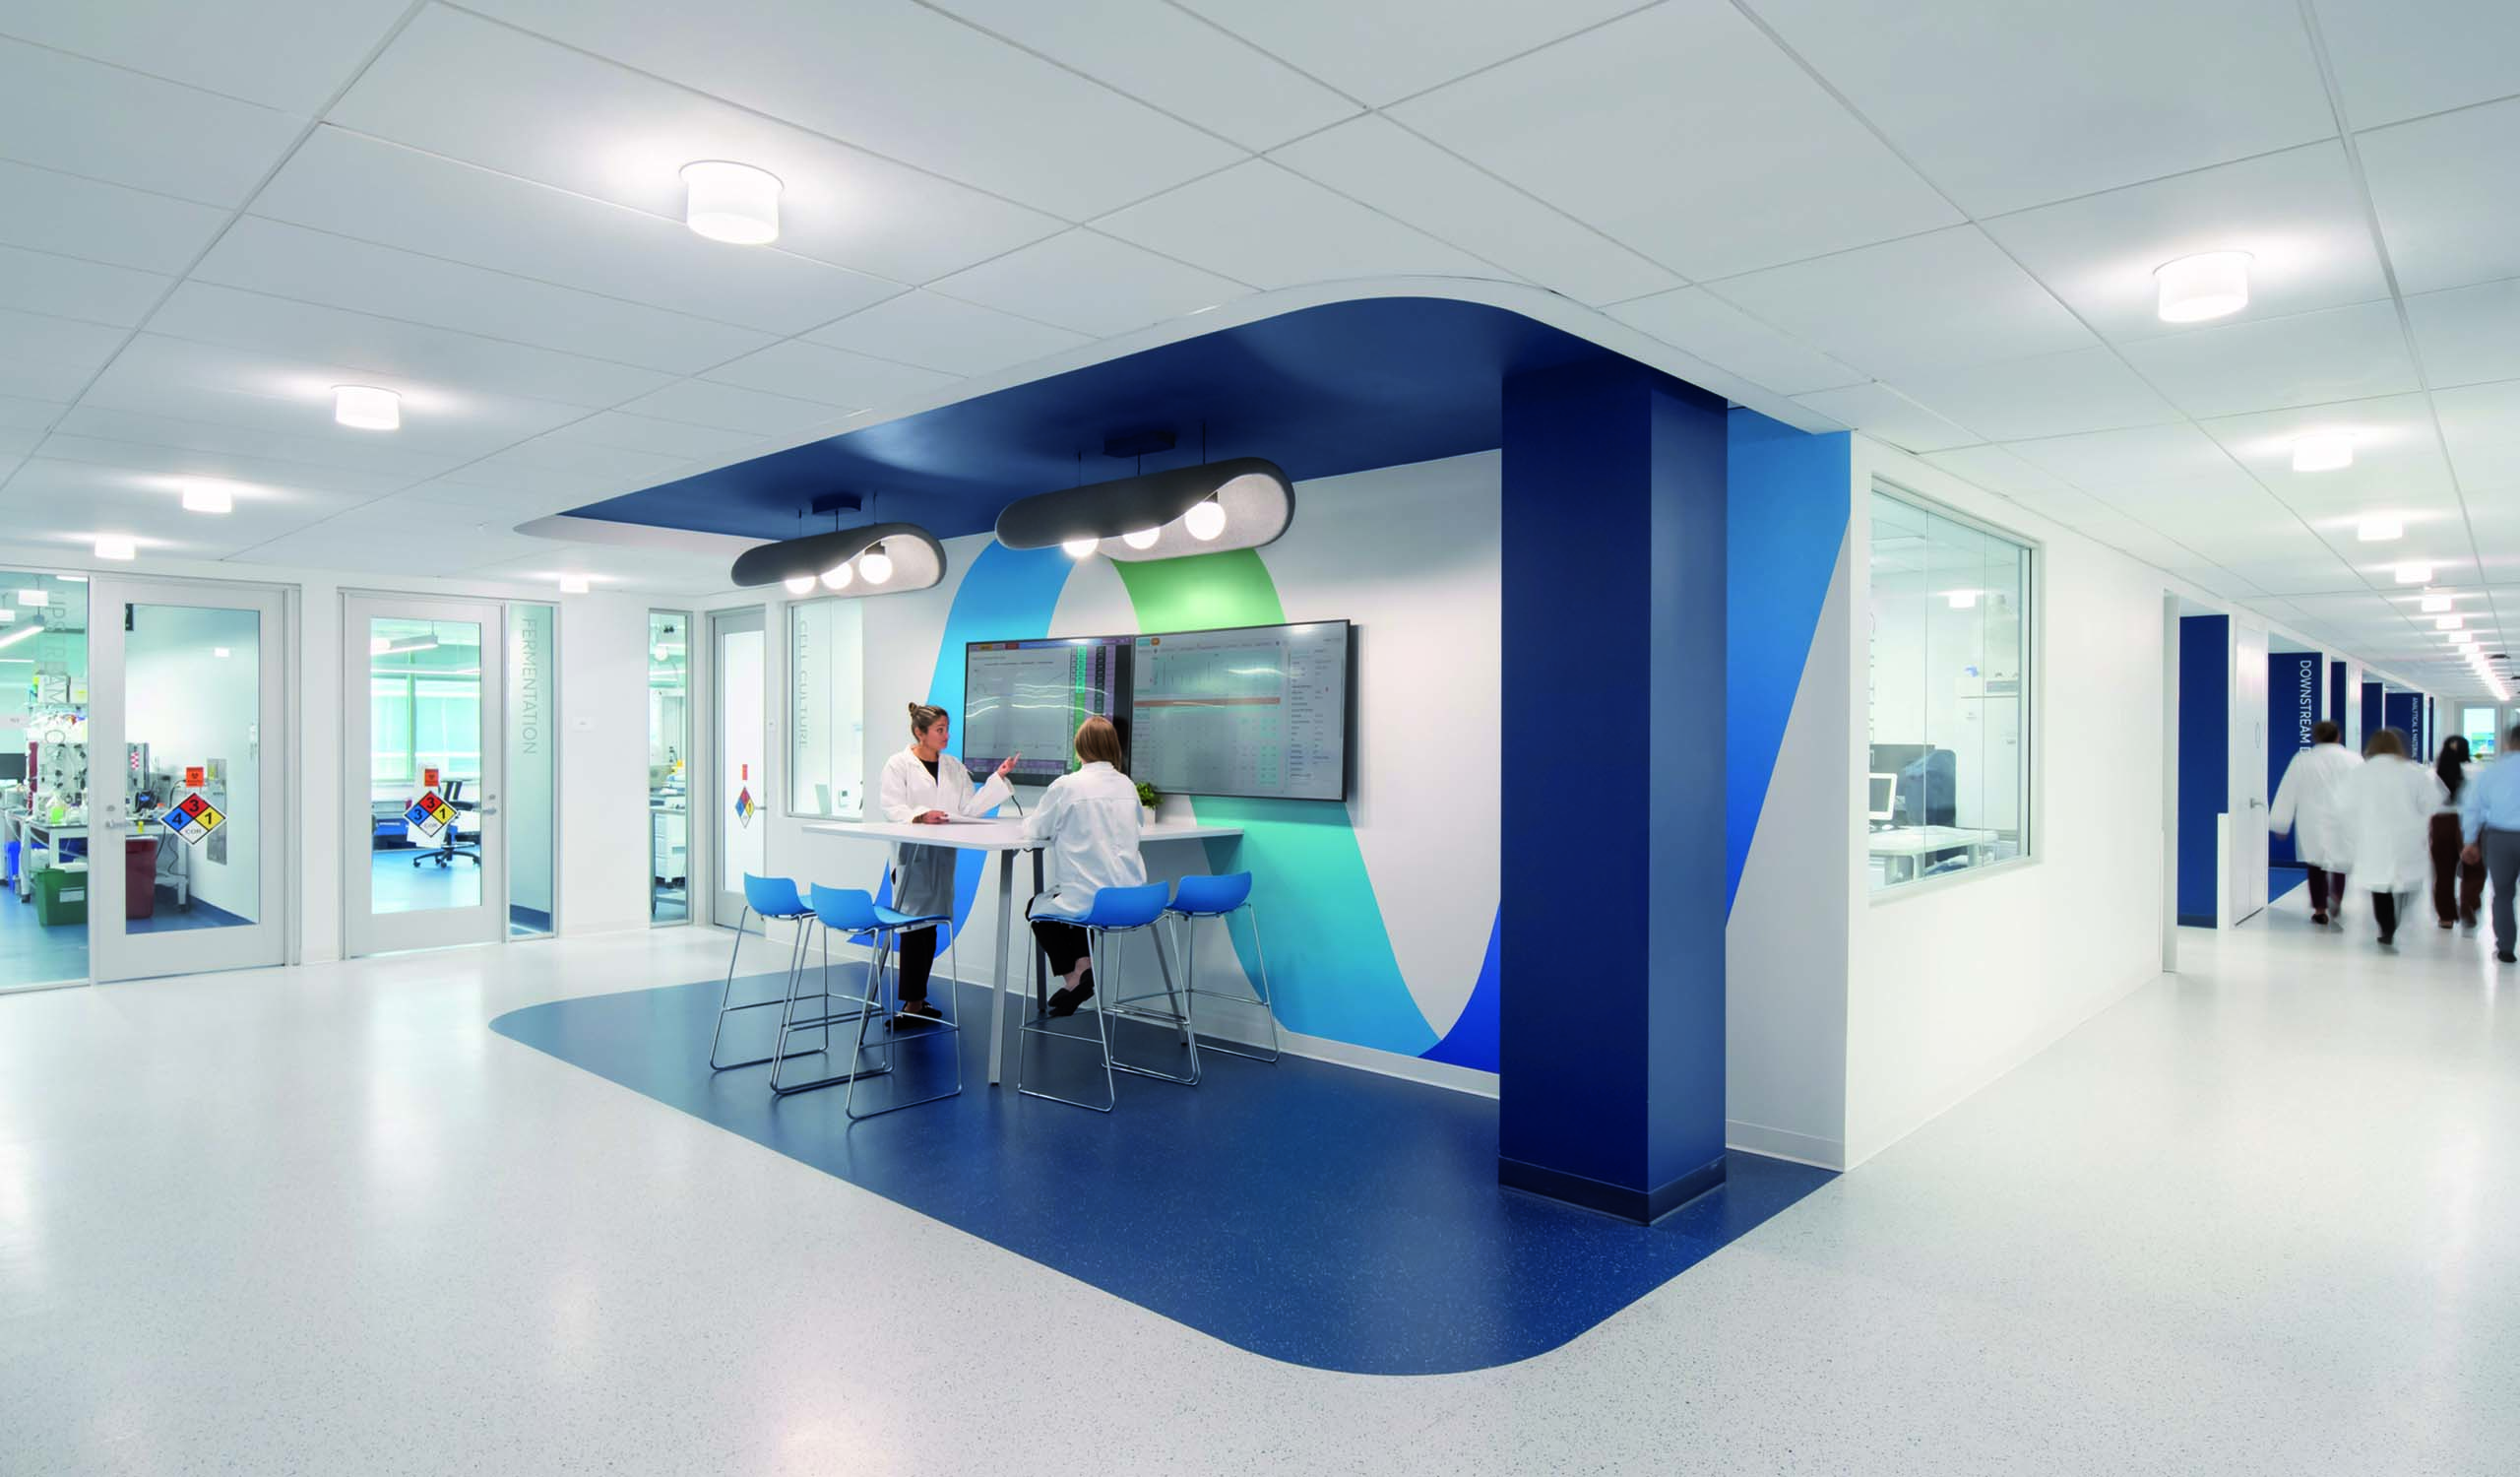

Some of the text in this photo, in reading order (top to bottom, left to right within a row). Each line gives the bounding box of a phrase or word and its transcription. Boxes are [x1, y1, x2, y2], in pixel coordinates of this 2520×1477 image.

[522, 618, 537, 754] FERMENTATION
[2300, 660, 2312, 743] DOWNSTREAM
[189, 800, 200, 812] 3
[427, 797, 435, 808] 3
[172, 812, 183, 825] 4
[204, 812, 212, 825] 1
[413, 808, 422, 820] 3
[439, 808, 446, 819] 1
